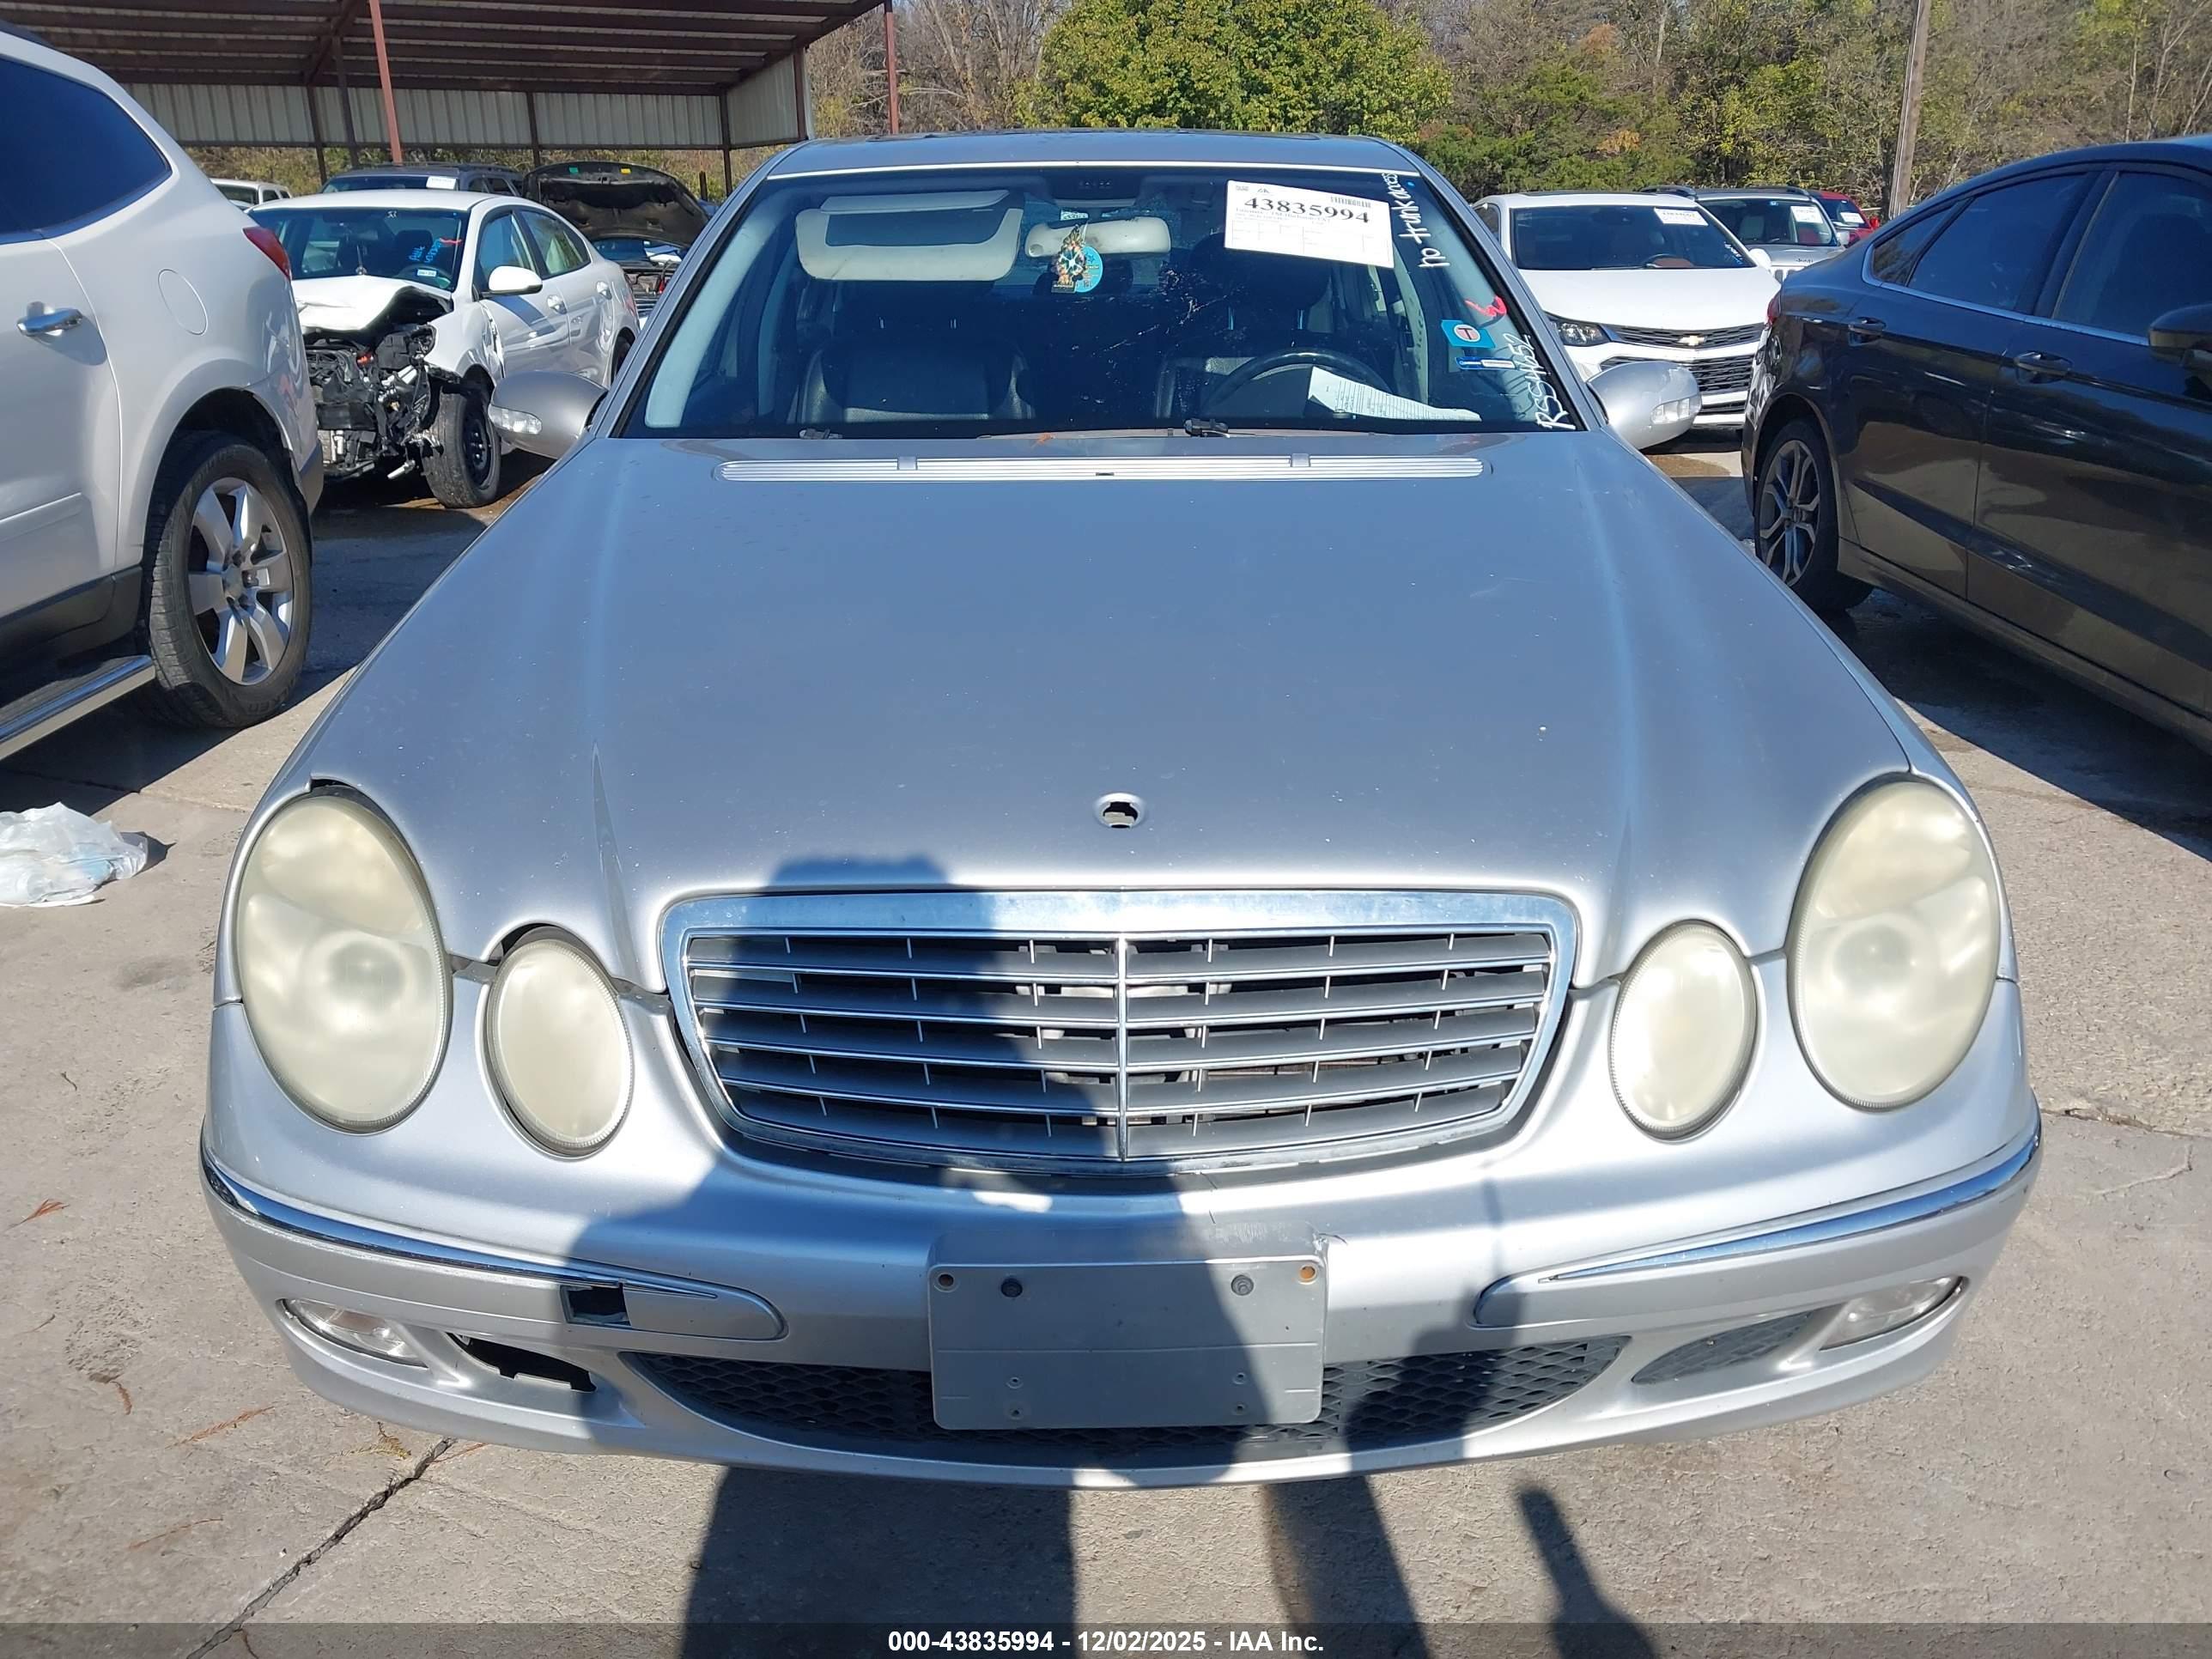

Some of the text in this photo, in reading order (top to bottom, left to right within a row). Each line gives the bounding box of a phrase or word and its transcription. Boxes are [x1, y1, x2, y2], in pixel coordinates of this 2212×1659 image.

[1244, 197, 1370, 223] 43835994
[1390, 200, 1431, 244] trunk
[1418, 247, 1450, 268] no
